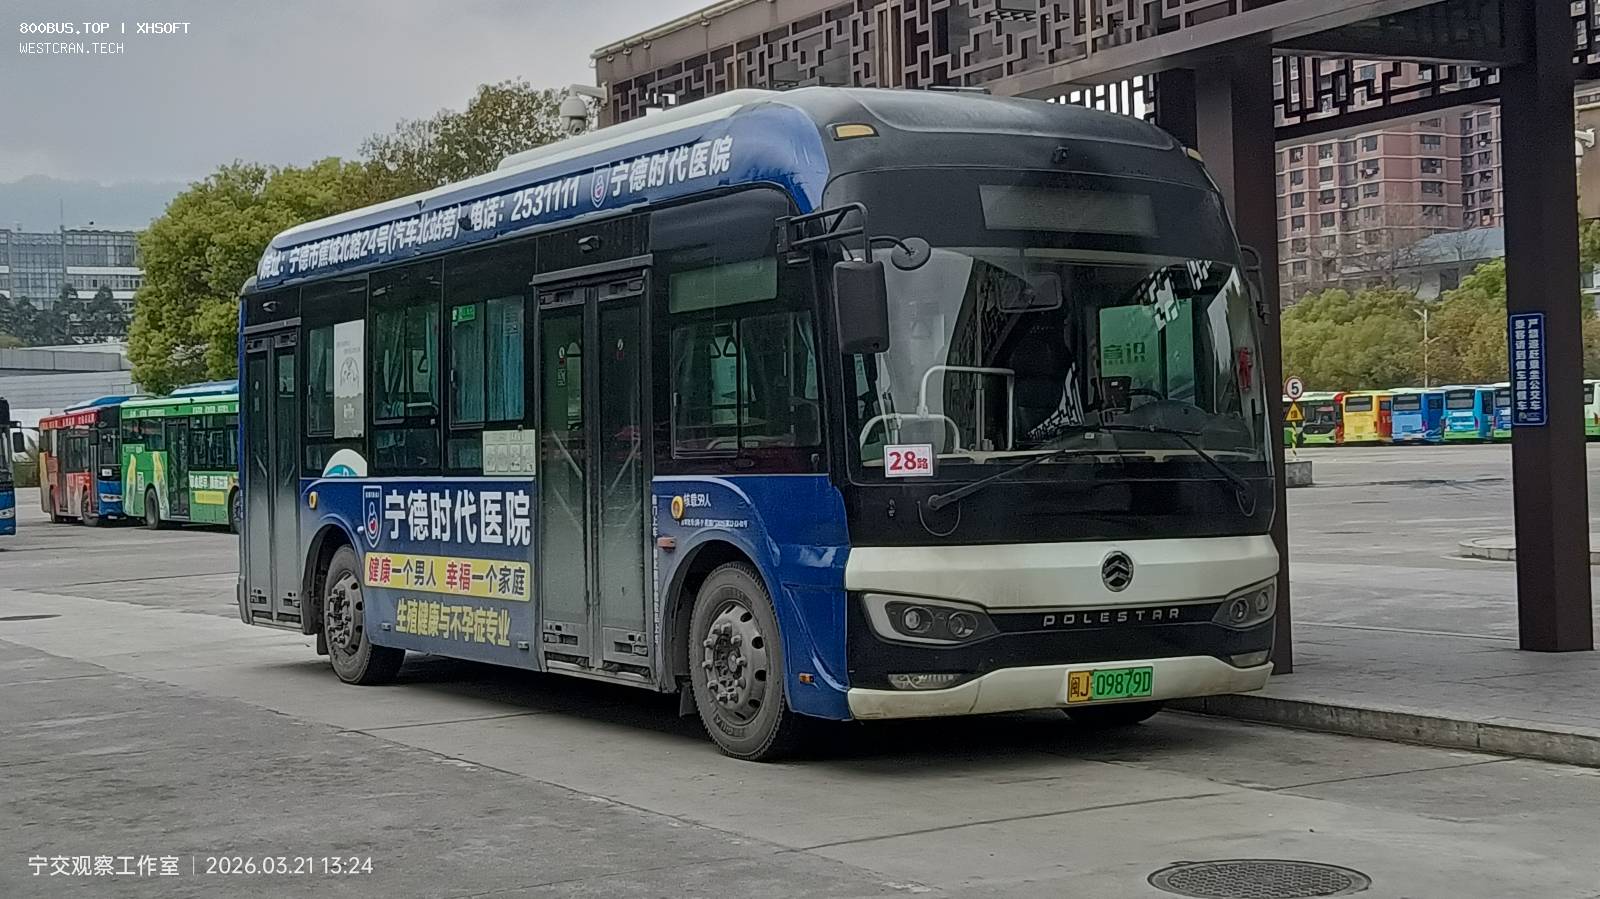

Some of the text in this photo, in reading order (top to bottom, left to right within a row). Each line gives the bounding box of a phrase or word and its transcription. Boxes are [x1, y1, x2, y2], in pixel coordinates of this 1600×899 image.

[611, 134, 733, 197] 宁德时代医院
[1290, 381, 1300, 396] 5
[889, 450, 929, 471] 28路
[385, 489, 531, 547] 宁德时代医院
[368, 557, 526, 597] 健康一个男人 幸福一个家庭
[394, 597, 512, 647] 生殖健康与不孕症专业
[1043, 607, 1180, 628] POLESTAR
[1070, 671, 1151, 699] 闽J 09879D
